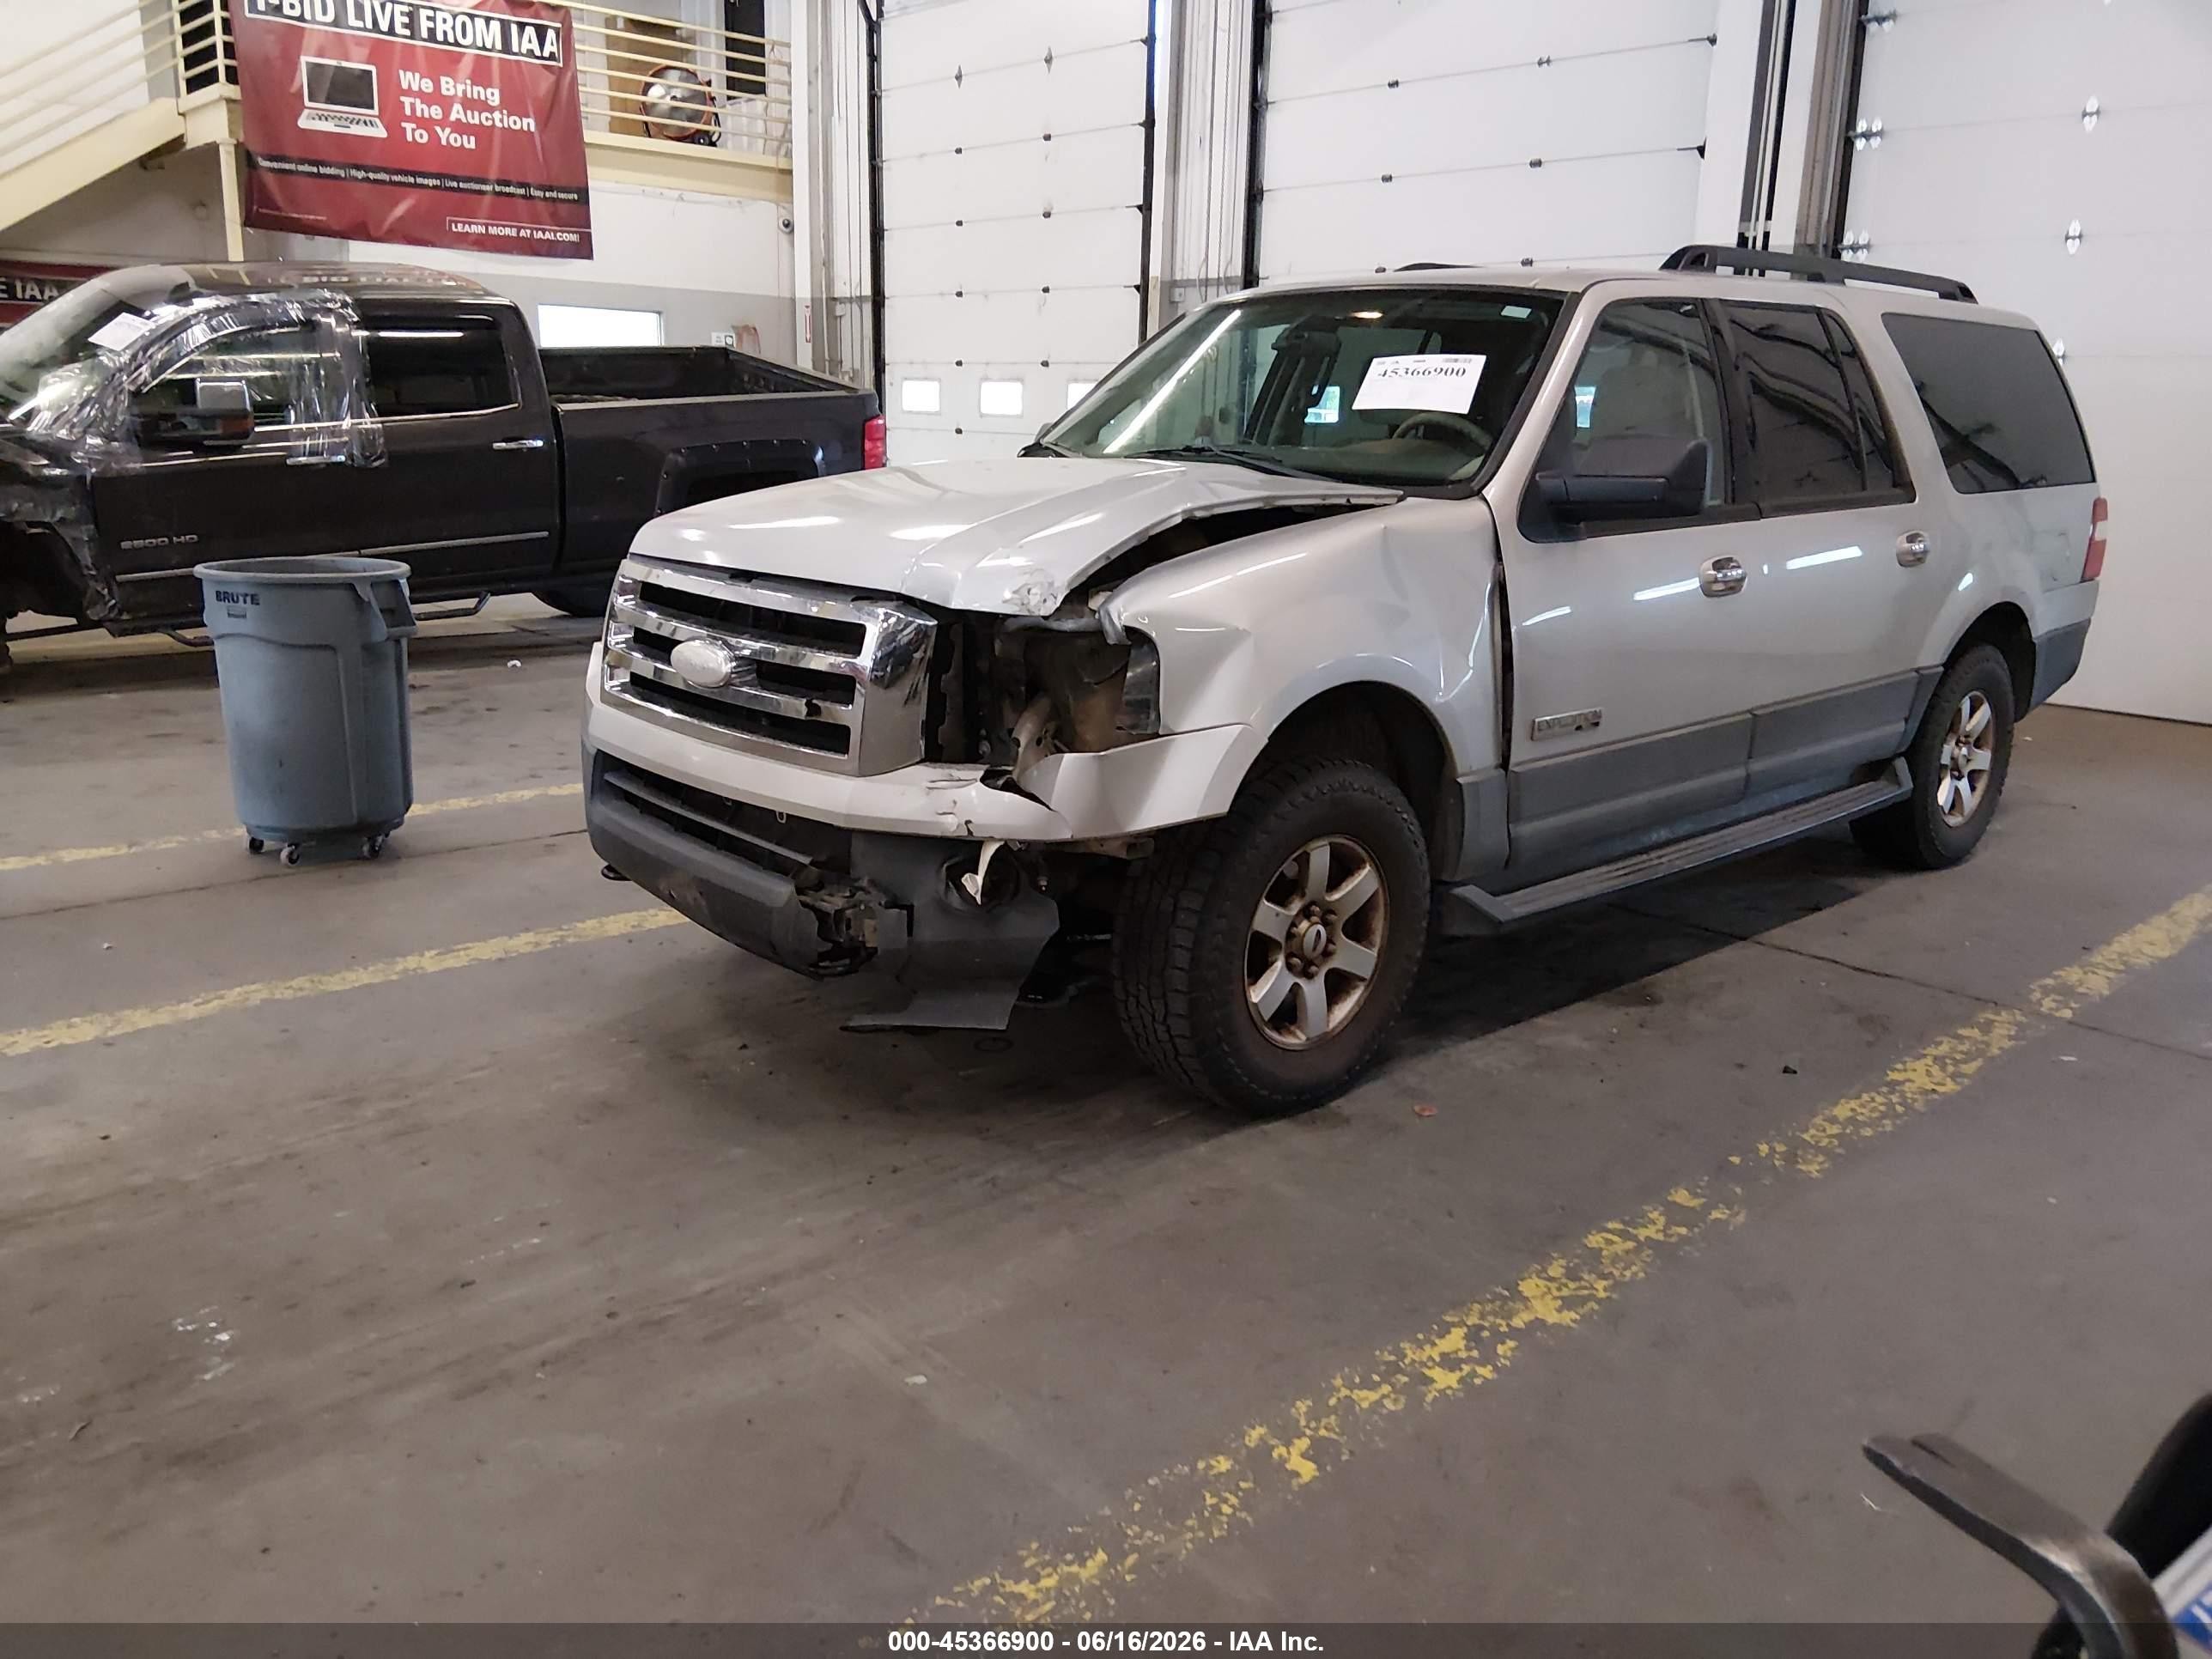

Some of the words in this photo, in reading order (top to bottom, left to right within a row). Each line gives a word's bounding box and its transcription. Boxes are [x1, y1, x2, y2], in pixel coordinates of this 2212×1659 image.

[346, 0, 411, 36] LIVE
[419, 8, 502, 51] FROM
[510, 23, 558, 58] IAA
[398, 70, 434, 93] We
[440, 76, 501, 106] Bring
[399, 96, 443, 120] The
[449, 103, 536, 132] Auction
[401, 122, 428, 144] To
[434, 125, 476, 149] You
[445, 179, 458, 188] Live
[544, 190, 557, 198] and
[452, 222, 486, 234] LEARN
[488, 225, 517, 237] MORE
[519, 228, 531, 238] AT
[1377, 366, 1467, 378] 45366900
[173, 534, 198, 544] HD
[216, 590, 260, 605] BRUTE
